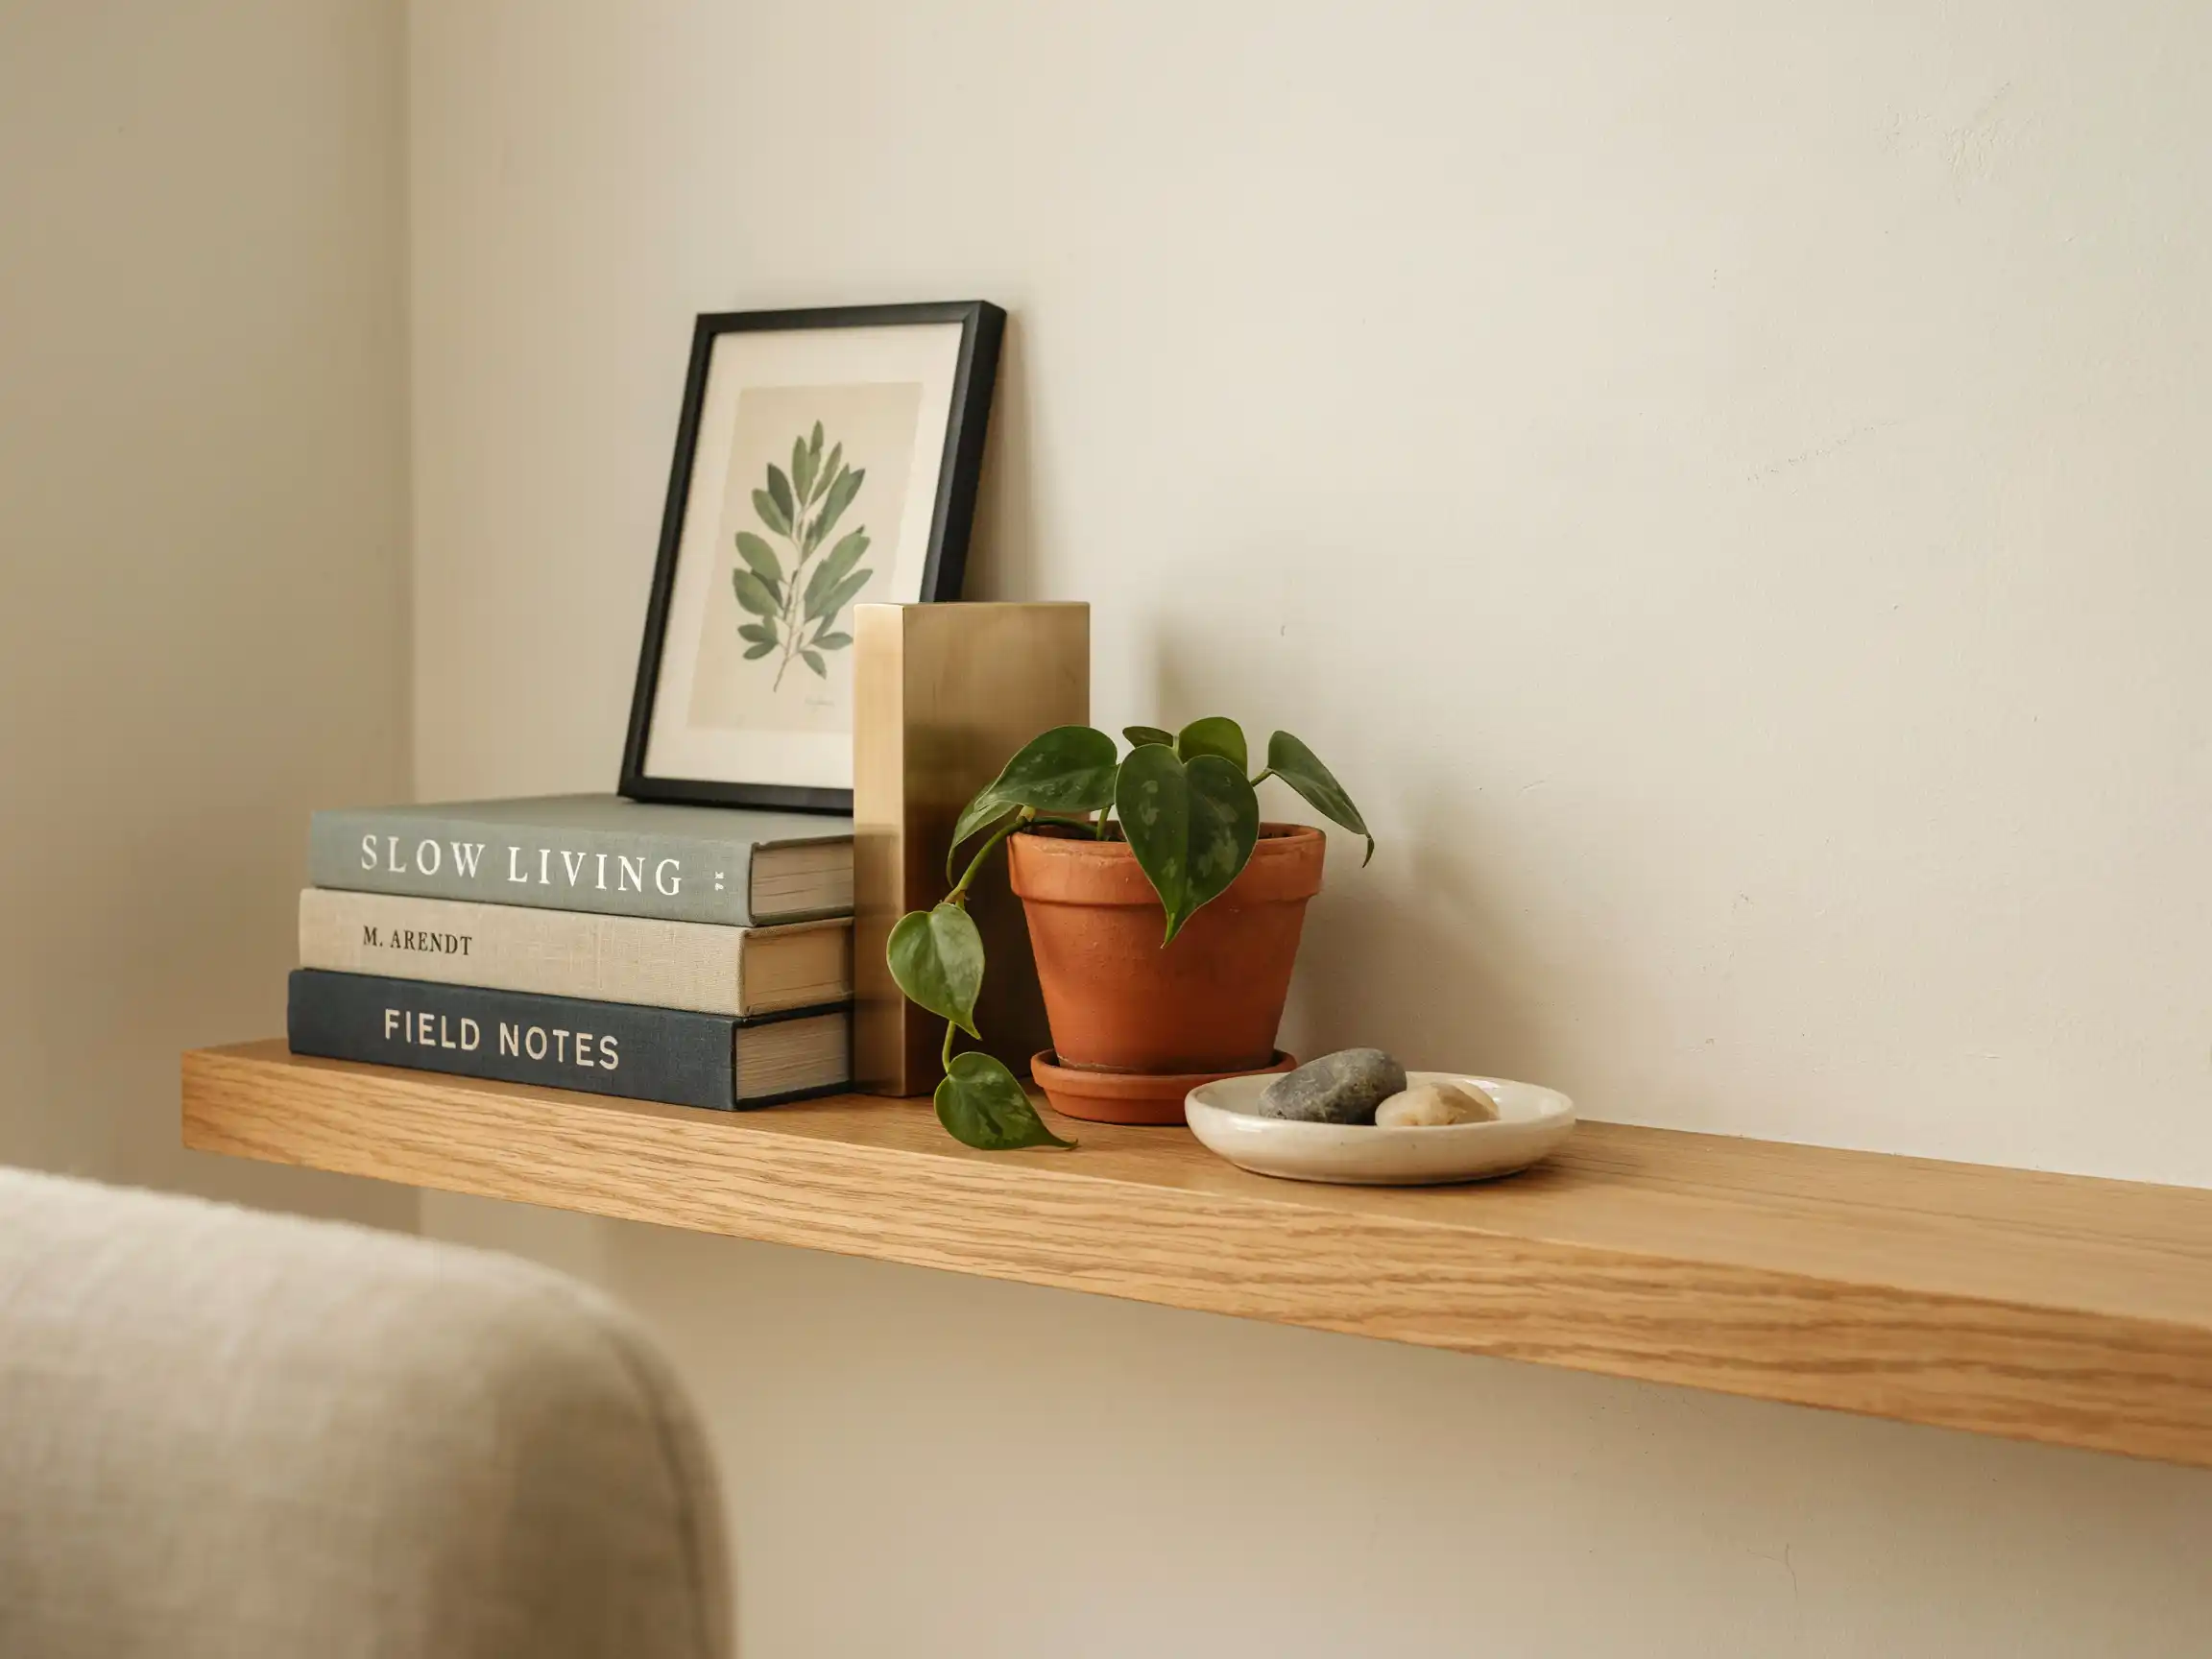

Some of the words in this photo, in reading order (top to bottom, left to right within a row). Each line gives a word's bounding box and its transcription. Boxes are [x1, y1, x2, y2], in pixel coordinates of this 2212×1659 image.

[361, 834, 486, 878] SLOW
[507, 846, 683, 896] LIVING
[363, 926, 384, 948] M.
[390, 929, 472, 956] ARENDT
[385, 1009, 480, 1051] FIELD
[499, 1022, 619, 1070] NOTES
